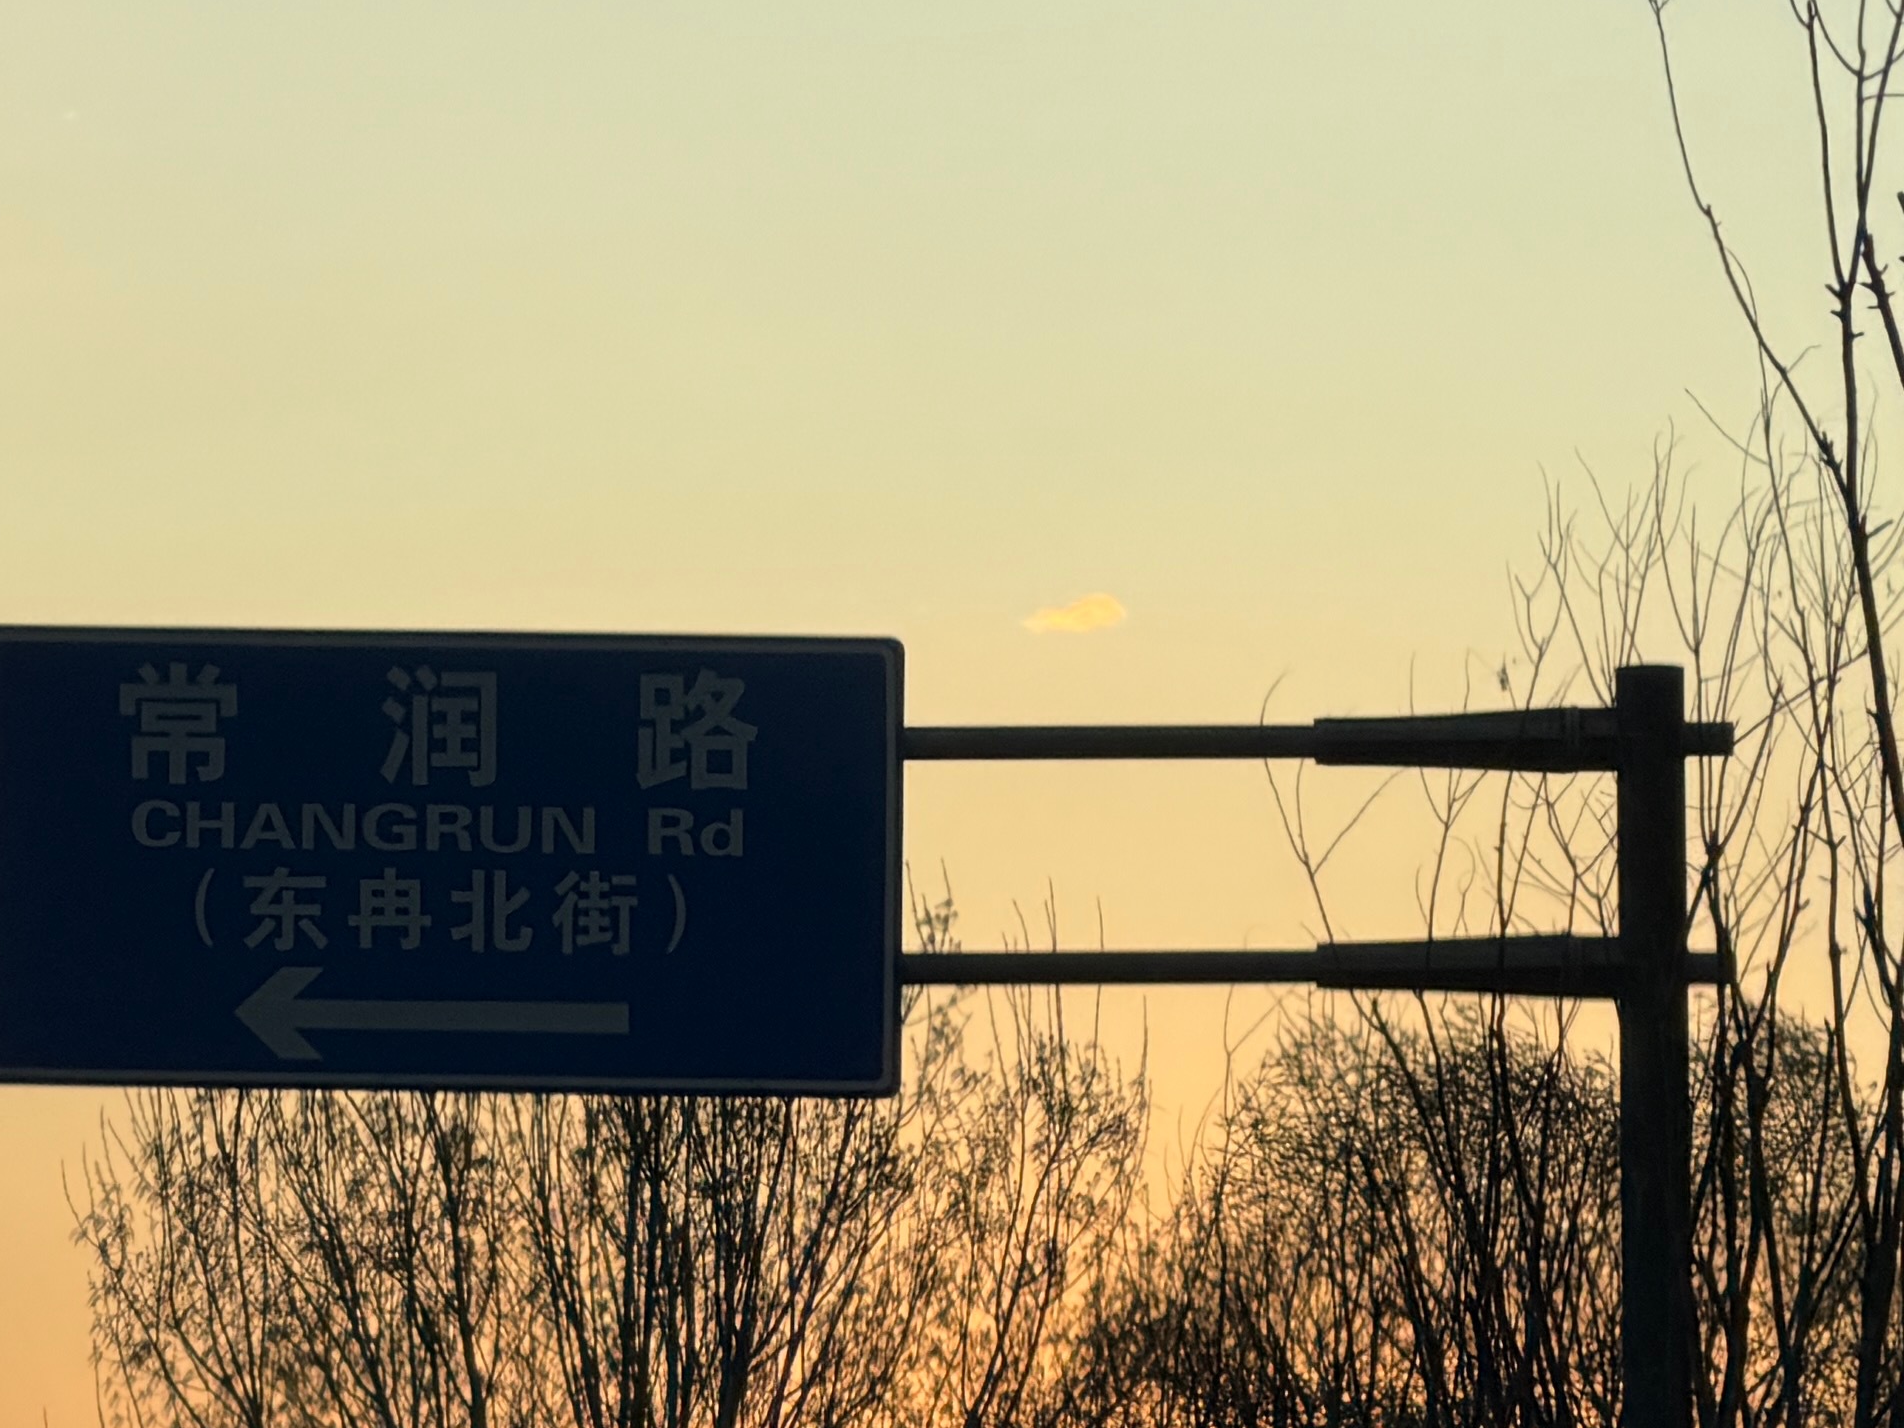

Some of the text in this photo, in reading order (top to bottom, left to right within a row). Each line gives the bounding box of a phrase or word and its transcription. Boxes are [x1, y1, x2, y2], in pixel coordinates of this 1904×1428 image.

[118, 661, 758, 791] 常润路
[130, 798, 744, 858] CHANGRUN Rd
